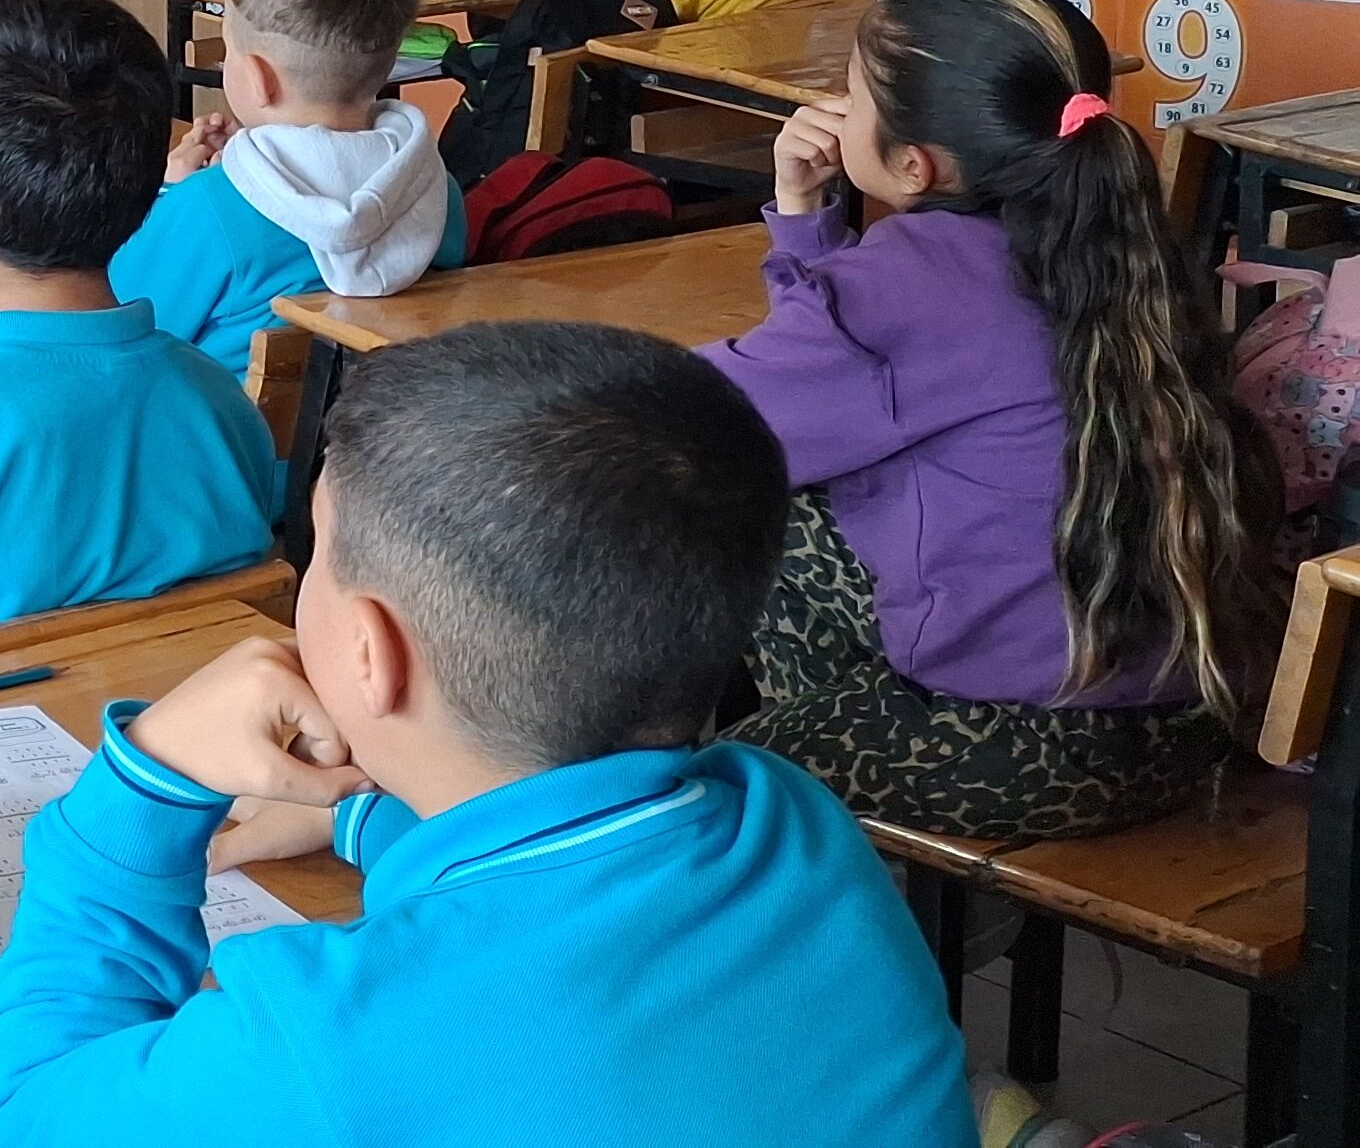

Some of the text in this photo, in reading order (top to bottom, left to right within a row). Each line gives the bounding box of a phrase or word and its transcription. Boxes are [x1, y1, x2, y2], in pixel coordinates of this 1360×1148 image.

[1205, 3, 1220, 13] 45
[1156, 16, 1171, 27] 27
[1215, 29, 1230, 40] 54
[1158, 42, 1171, 53] 18
[1182, 63, 1189, 73] 9
[1215, 57, 1230, 68] 63
[1210, 84, 1224, 94] 72
[1192, 103, 1205, 114] 81
[1166, 111, 1181, 121] 90
